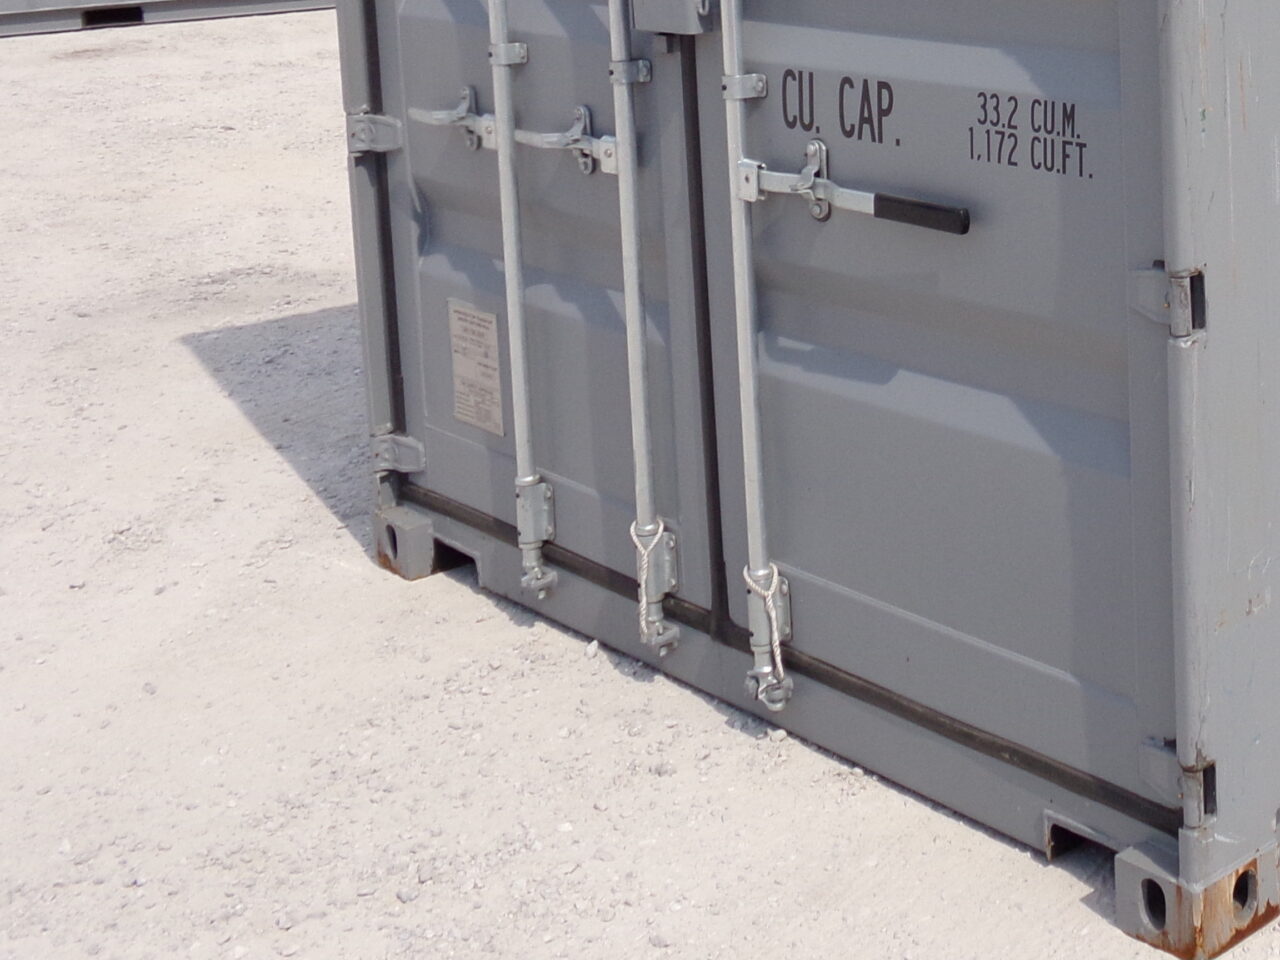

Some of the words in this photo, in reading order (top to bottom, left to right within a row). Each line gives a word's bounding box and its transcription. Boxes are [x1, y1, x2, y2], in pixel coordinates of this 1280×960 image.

[781, 68, 821, 134] CU.
[838, 75, 901, 147] CAP.
[976, 91, 1018, 130] 33.2
[1030, 98, 1081, 139] CU.M.
[967, 126, 1018, 166] 1,172
[1029, 135, 1094, 179] CU.FT.
